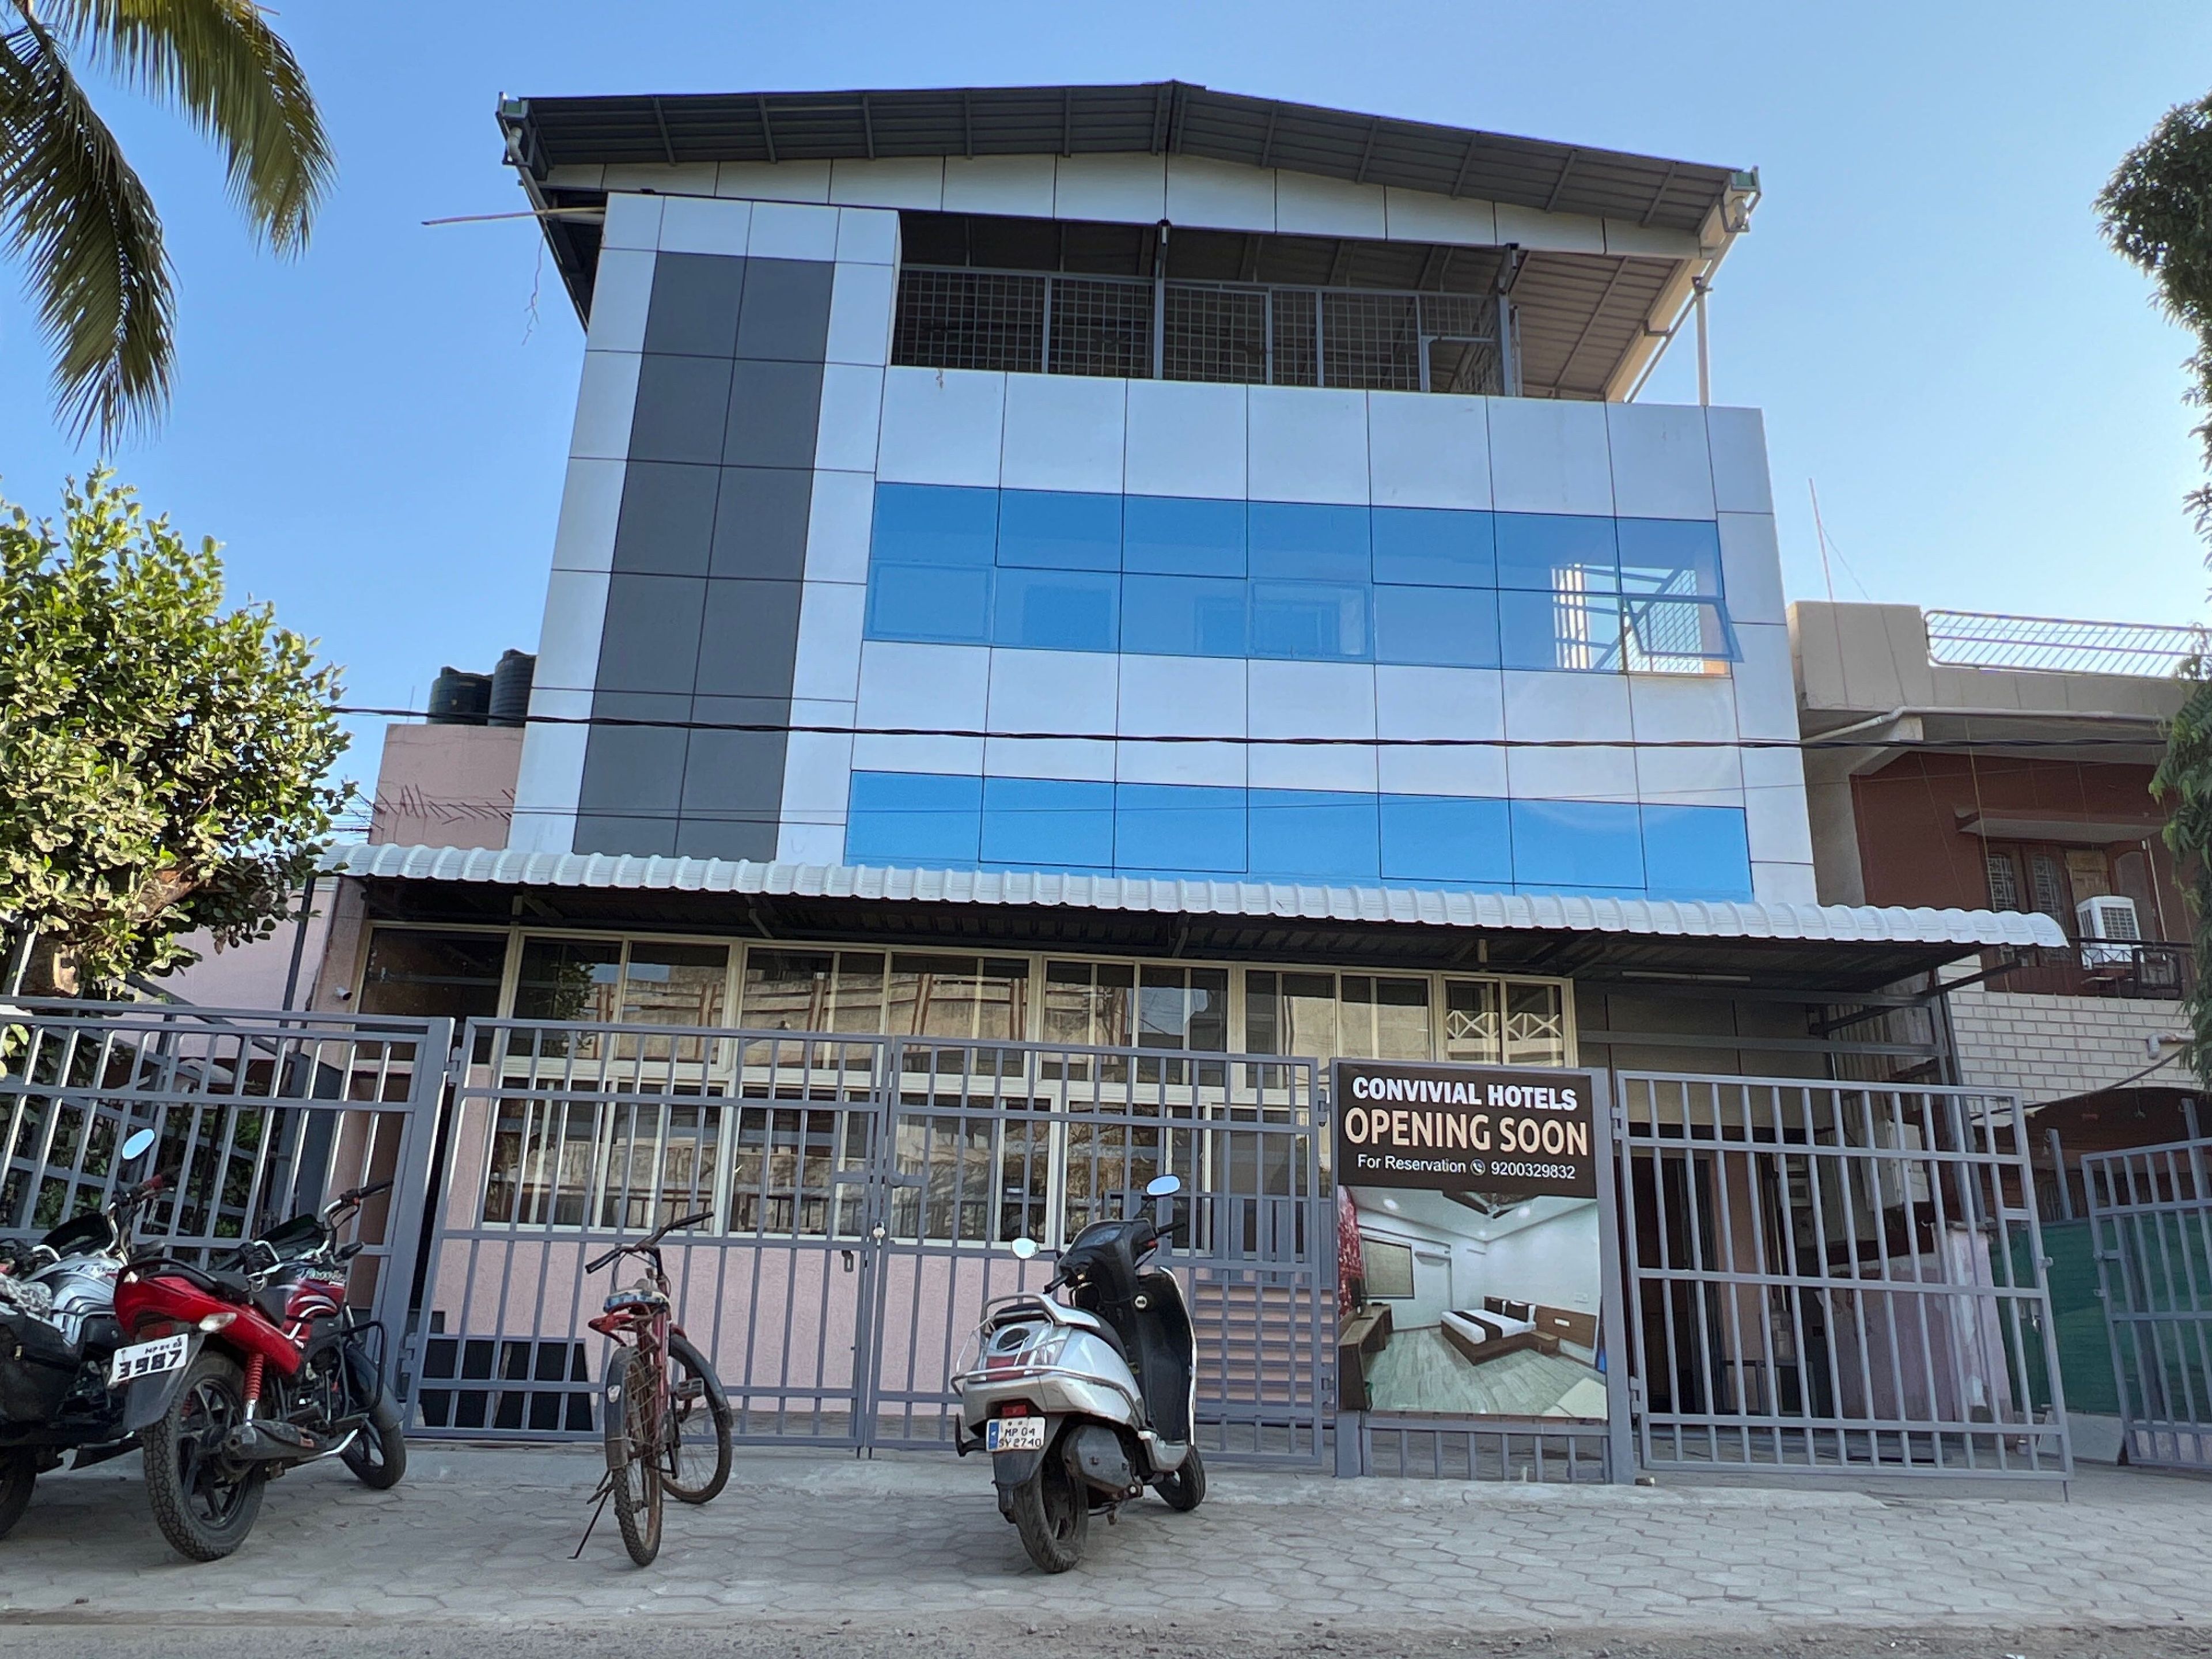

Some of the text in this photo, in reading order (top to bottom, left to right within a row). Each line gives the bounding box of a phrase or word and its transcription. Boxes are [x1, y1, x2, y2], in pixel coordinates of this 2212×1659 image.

[1353, 1077, 1577, 1111] CONVIVIAL HOTELS
[1344, 1107, 1588, 1156] OPENING SOON
[1358, 1154, 1575, 1179] For Reservation 9200329832
[118, 1349, 182, 1379] 3987
[1005, 1427, 1036, 1437] MP 04
[1014, 1437, 1041, 1447] 2740
